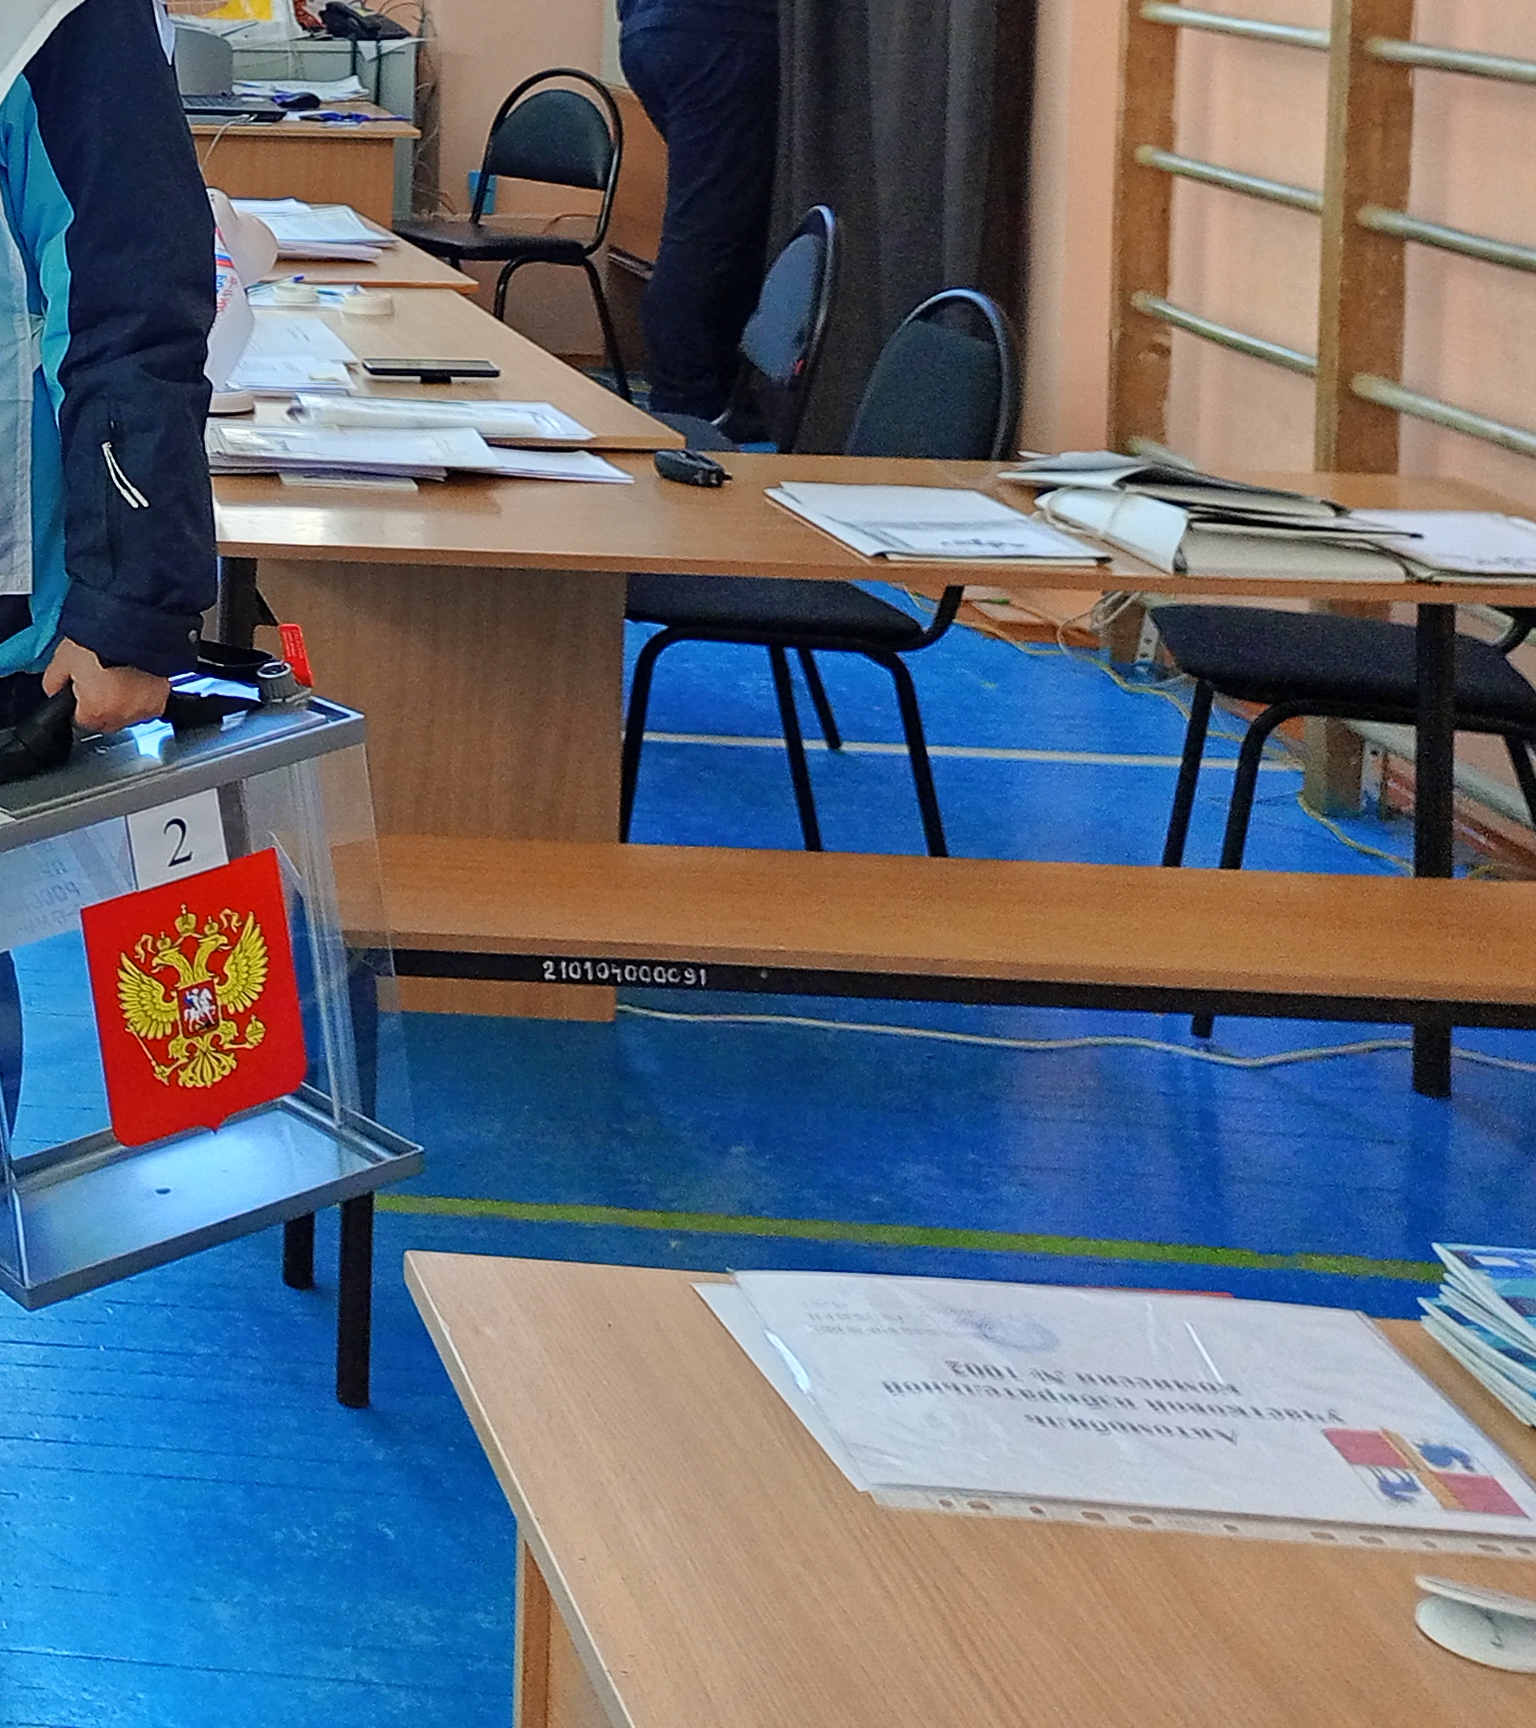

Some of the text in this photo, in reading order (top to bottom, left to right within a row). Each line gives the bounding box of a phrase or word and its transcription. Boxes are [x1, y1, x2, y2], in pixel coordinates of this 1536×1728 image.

[164, 818, 193, 868] 2
[945, 1360, 1024, 1382] 1002
[881, 1380, 1137, 1410] избирательной
[1024, 1413, 1237, 1444] Автомобиль
